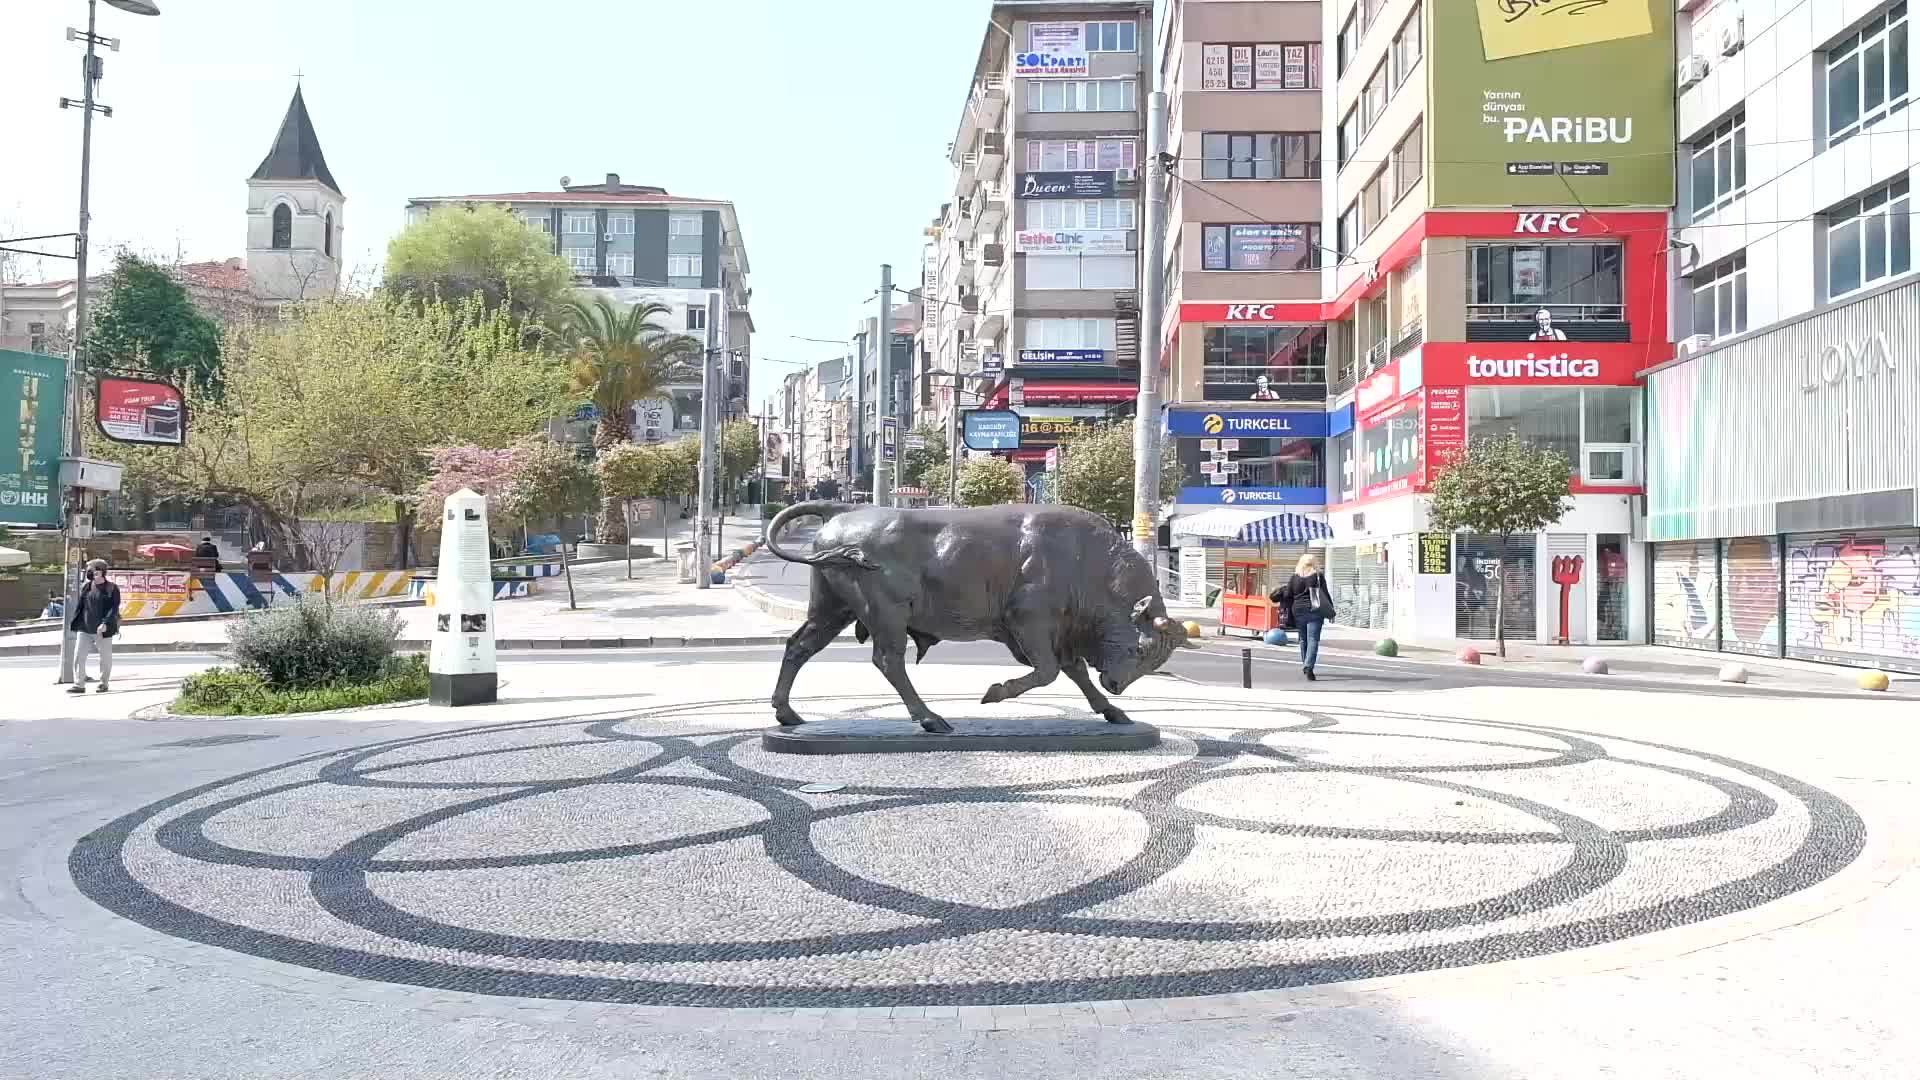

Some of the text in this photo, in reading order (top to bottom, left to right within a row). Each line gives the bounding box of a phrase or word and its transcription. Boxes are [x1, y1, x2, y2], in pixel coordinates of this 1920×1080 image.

[1016, 53, 1050, 67] SOL
[1483, 90, 1521, 99] Yarının
[1483, 102, 1526, 113] dünyası
[1483, 114, 1500, 123] bu.
[1021, 179, 1067, 197] Queen
[1514, 213, 1580, 233] KFC
[1225, 304, 1277, 320] KFC
[1467, 353, 1600, 377] touristica
[1800, 331, 1897, 394] LOYA
[1227, 418, 1292, 430] TURKCELL
[1238, 491, 1283, 501] TURKCELL
